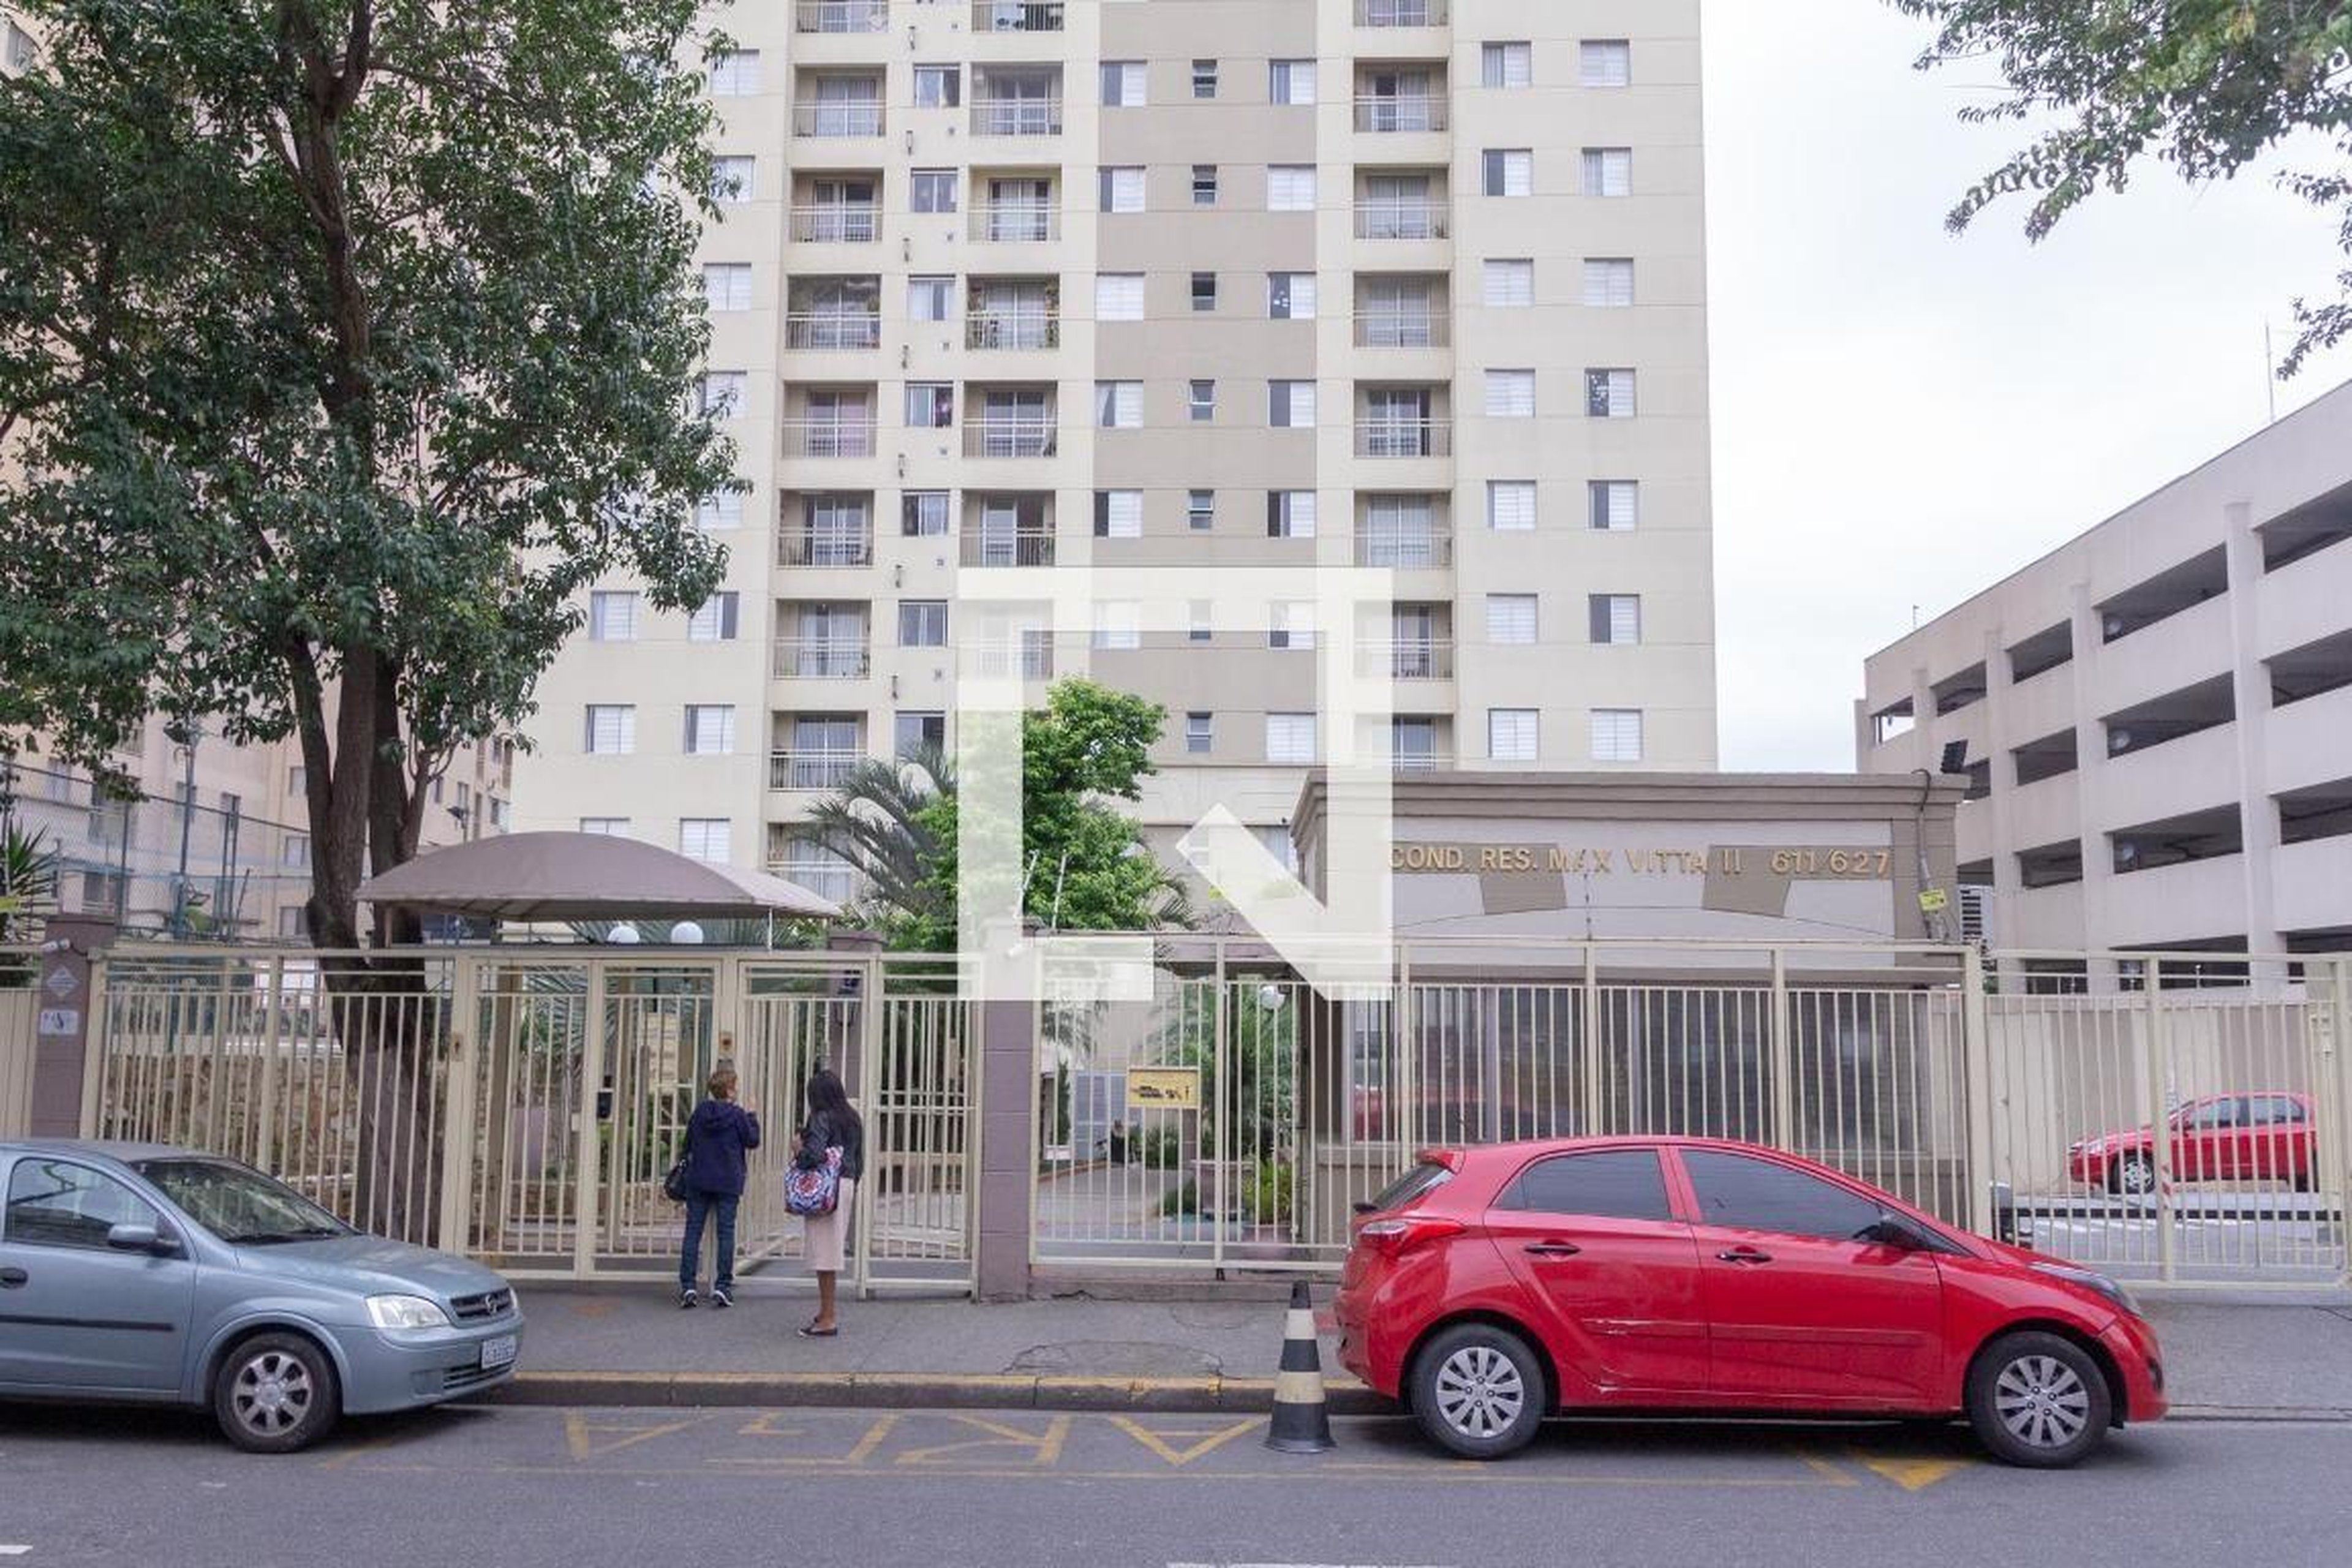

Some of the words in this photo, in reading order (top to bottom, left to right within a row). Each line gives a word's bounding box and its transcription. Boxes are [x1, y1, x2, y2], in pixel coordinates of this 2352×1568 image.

[1481, 848, 1537, 871] RES.
[1548, 848, 1613, 873] MAX
[1624, 848, 1709, 874] VITTA
